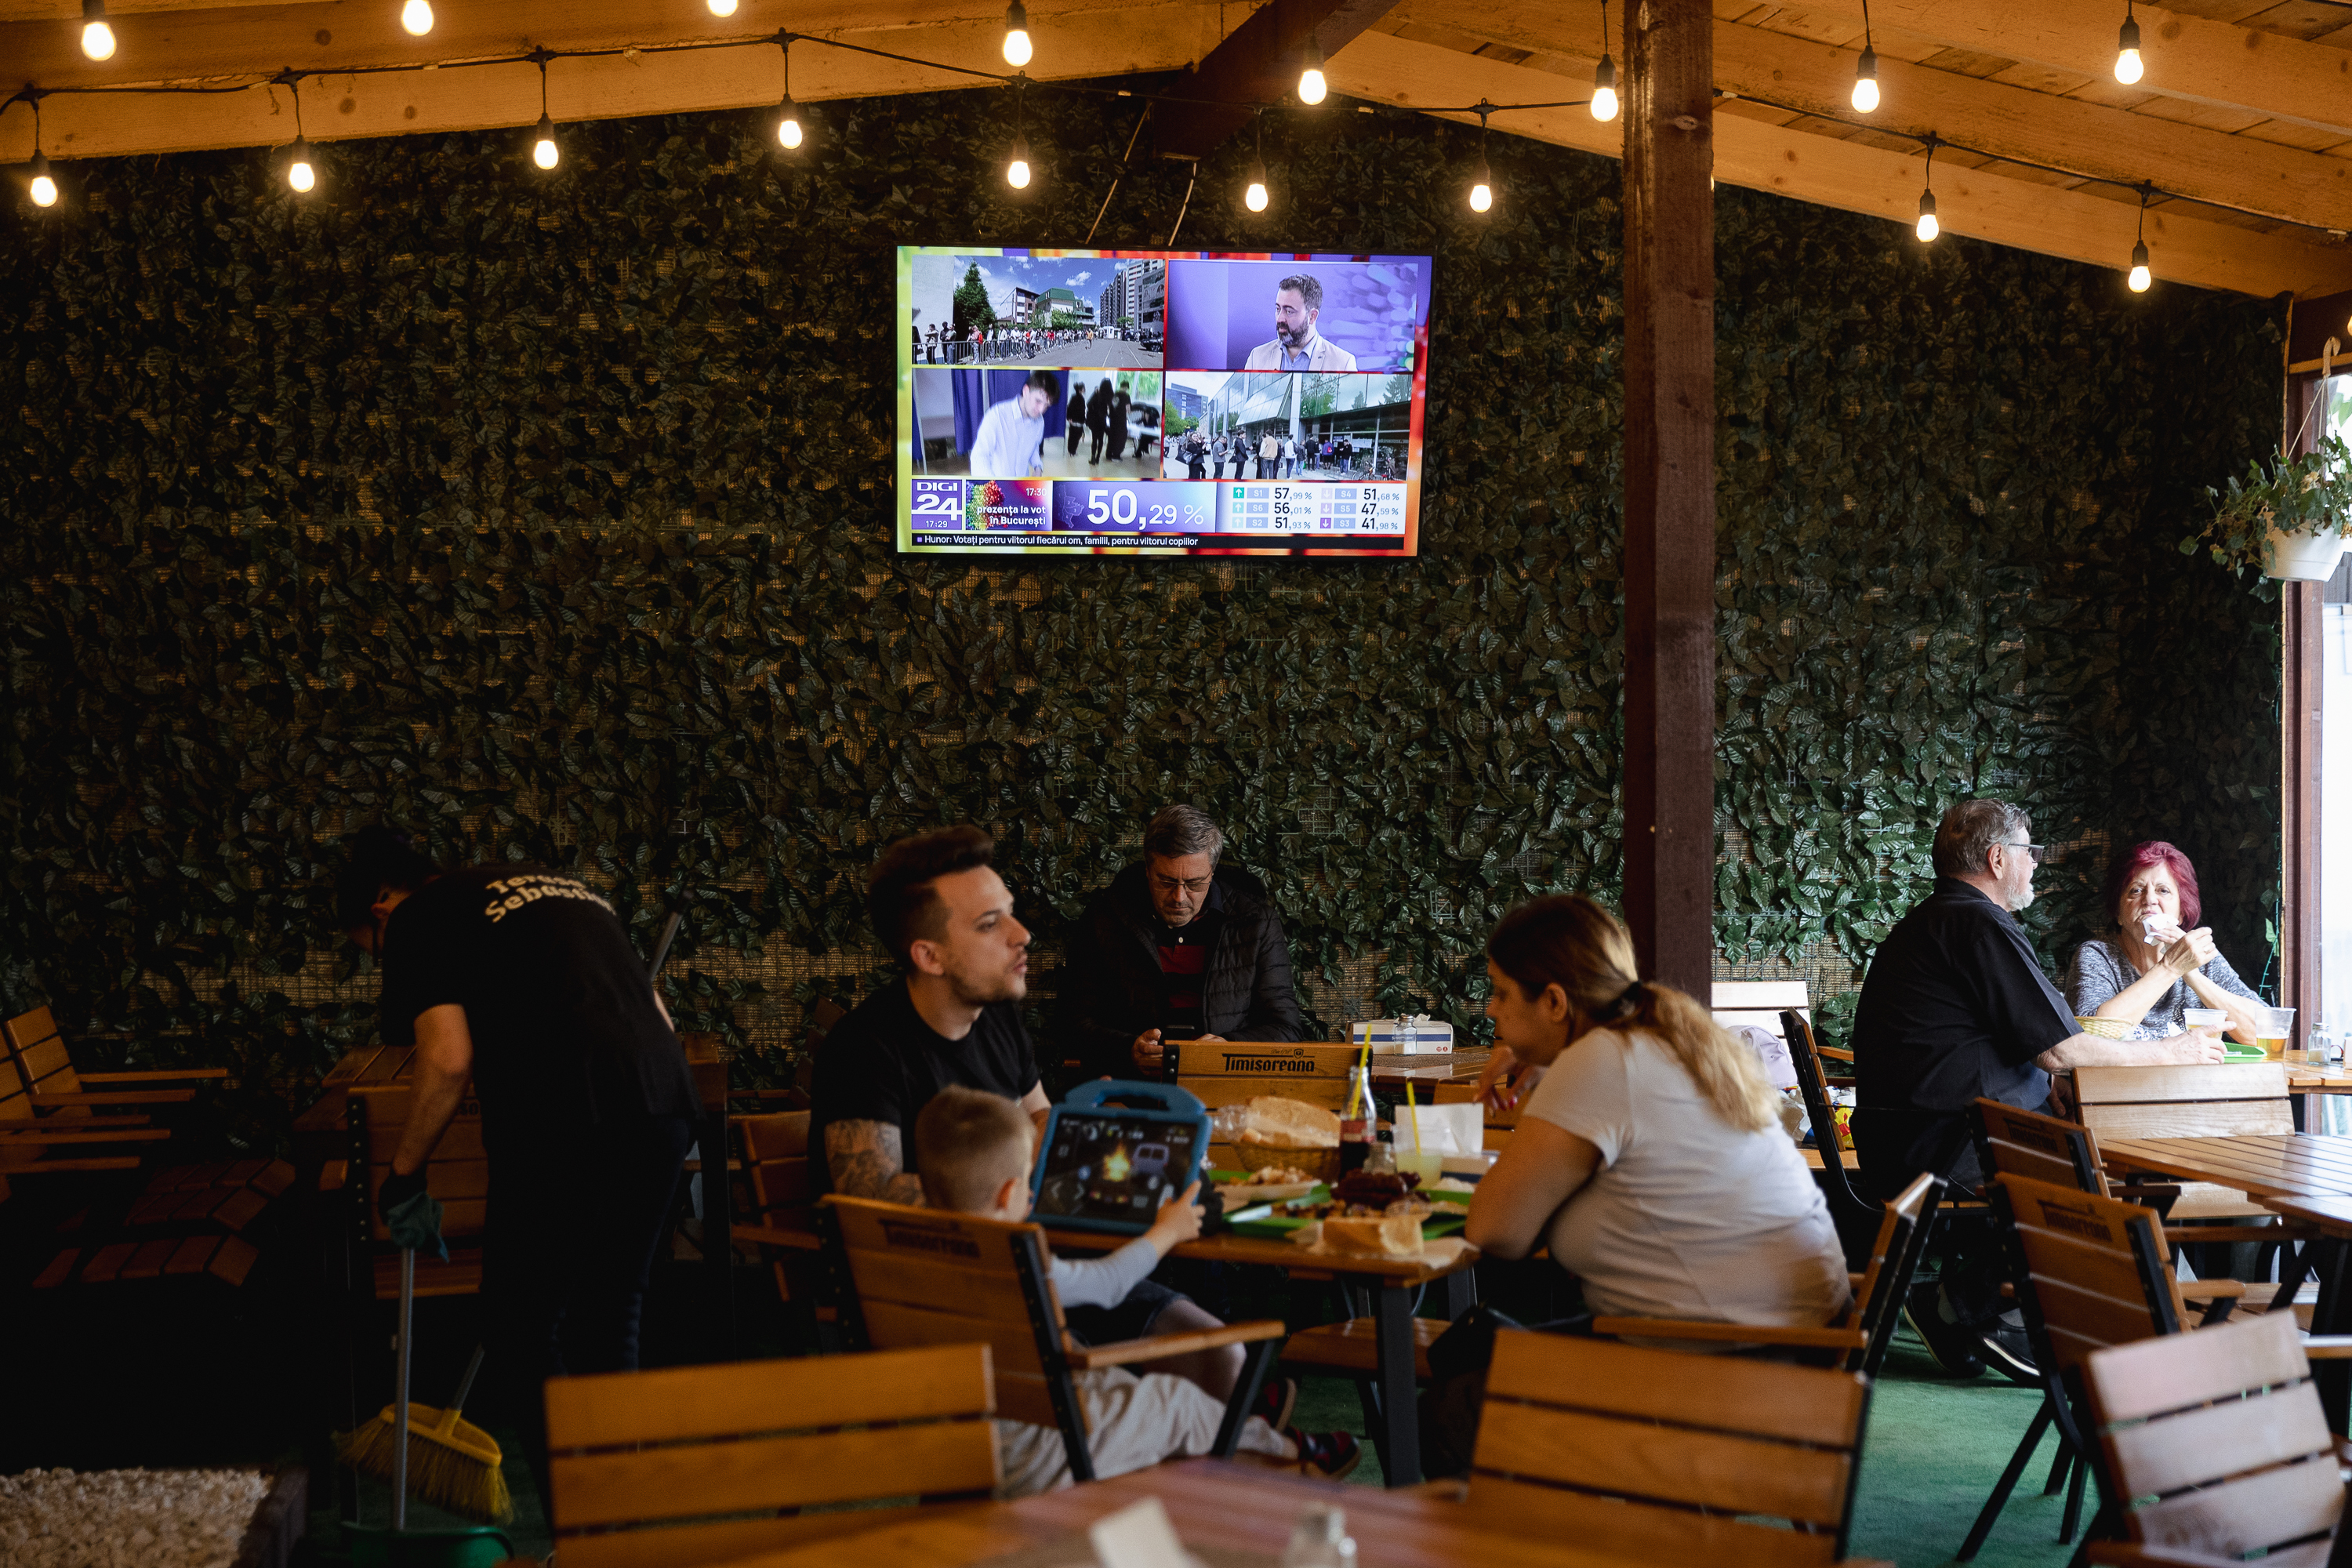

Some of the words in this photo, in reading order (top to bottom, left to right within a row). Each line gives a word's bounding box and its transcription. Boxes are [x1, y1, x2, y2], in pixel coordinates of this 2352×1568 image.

[916, 482, 958, 491] DIGI
[1025, 488, 1047, 496] 17:30
[1274, 488, 1303, 501] 57,99
[1363, 488, 1390, 502] 51,68
[916, 493, 958, 521] 24
[976, 506, 1018, 516] prezența
[1087, 488, 1177, 531] 50,29
[1183, 504, 1204, 525] %
[1274, 503, 1302, 516] 56,01
[1361, 503, 1389, 517] 47,59
[989, 516, 1000, 524] în
[1000, 517, 1046, 528] București
[1275, 517, 1302, 530] 51,93
[1361, 518, 1389, 532] 41,98
[979, 536, 1006, 545] pentru
[1007, 535, 1035, 544] viitorul
[1084, 536, 1110, 546] familii,
[1112, 538, 1138, 547] pentru
[1140, 537, 1167, 546] viitorul
[1168, 537, 1199, 547] copiilor
